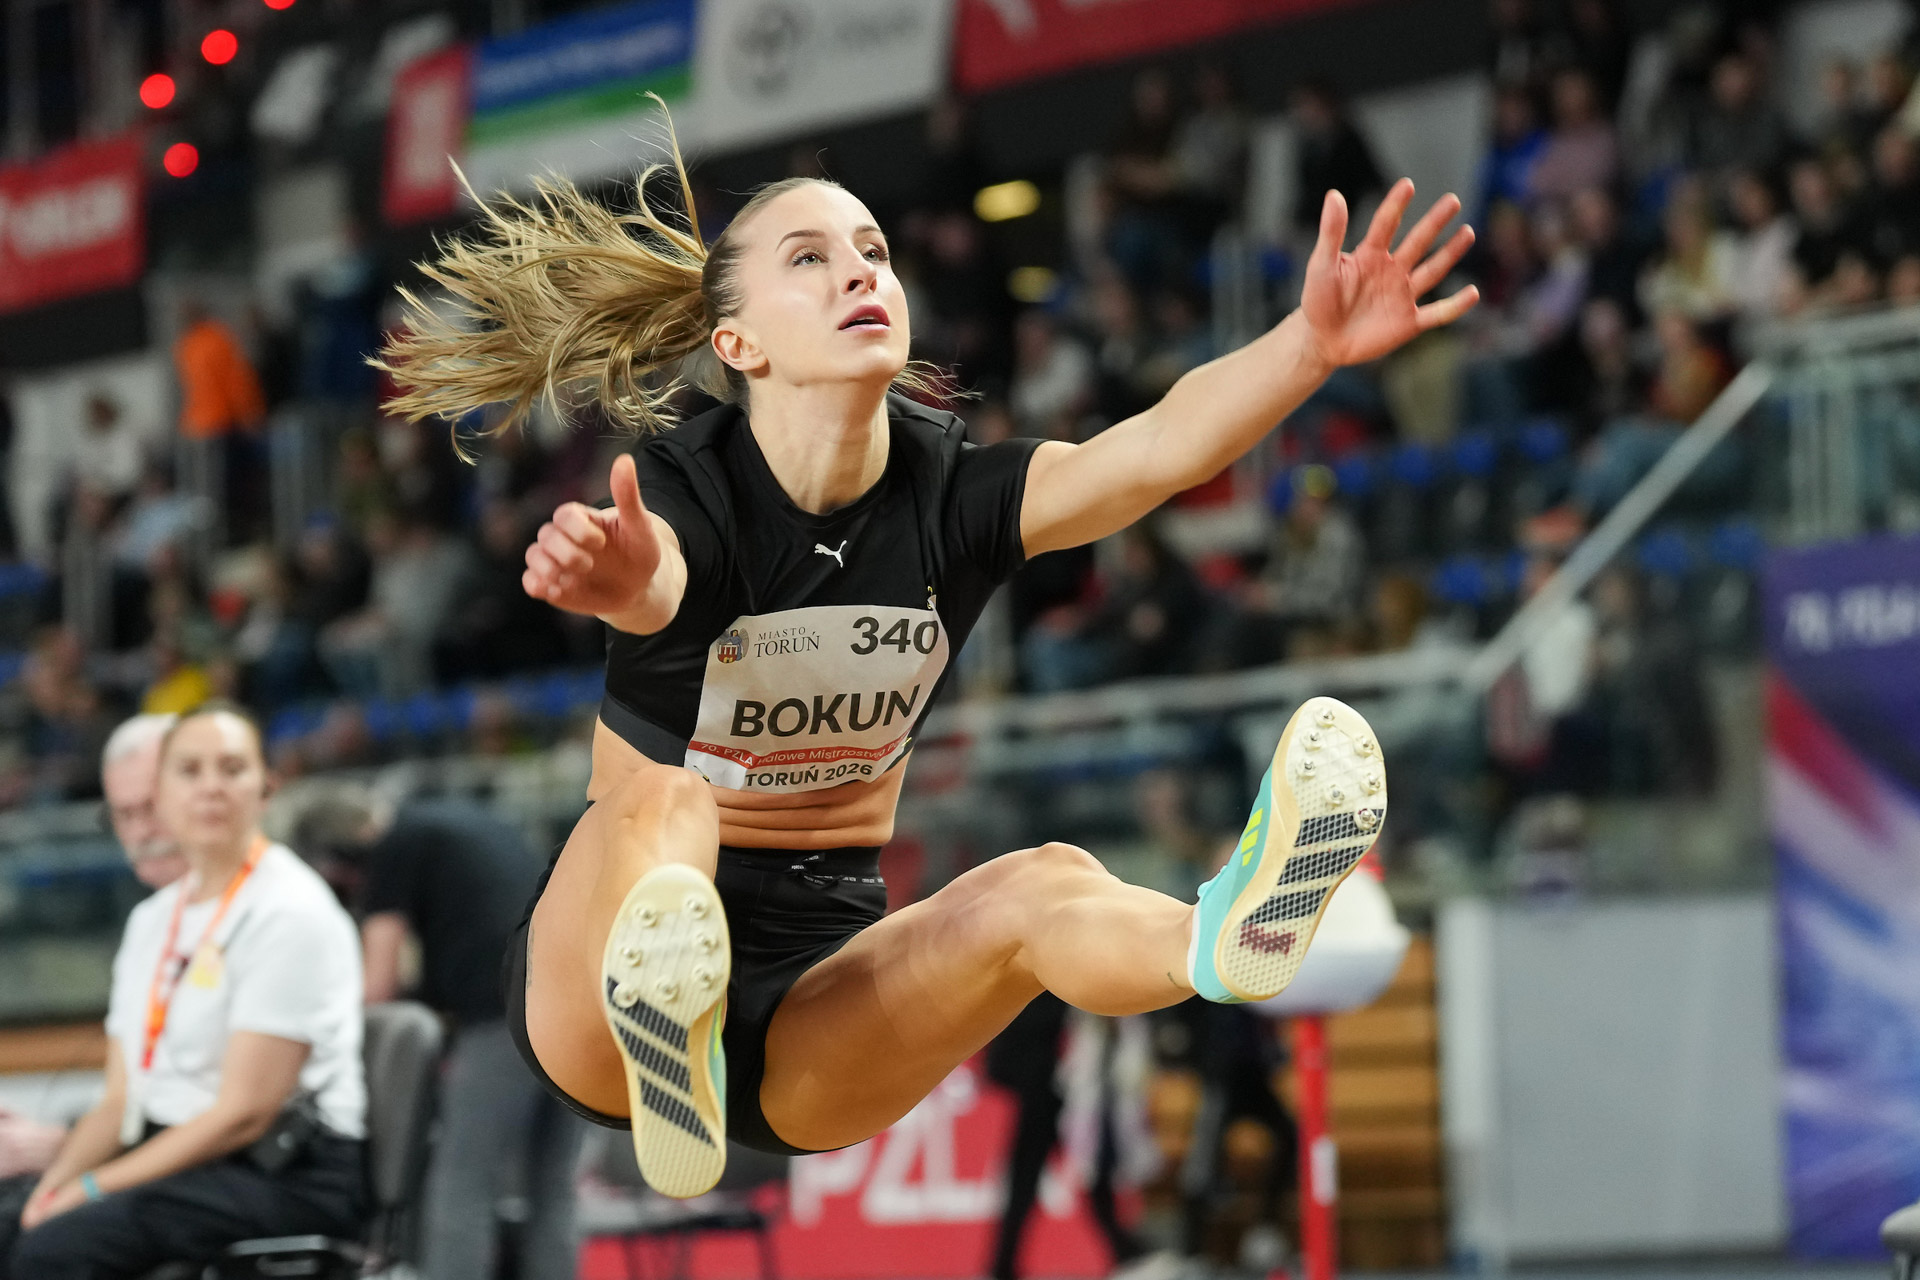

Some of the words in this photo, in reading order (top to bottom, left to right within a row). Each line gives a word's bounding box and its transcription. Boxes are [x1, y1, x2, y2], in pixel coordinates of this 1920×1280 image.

[753, 631, 820, 658] TORUŃ
[758, 626, 806, 641] MIASTO
[850, 616, 939, 655] 340
[729, 684, 921, 738] BOKUN
[701, 743, 719, 753] 70.
[723, 748, 754, 767] PZLA
[745, 764, 819, 787] TORUŃ
[823, 763, 873, 781] 2026
